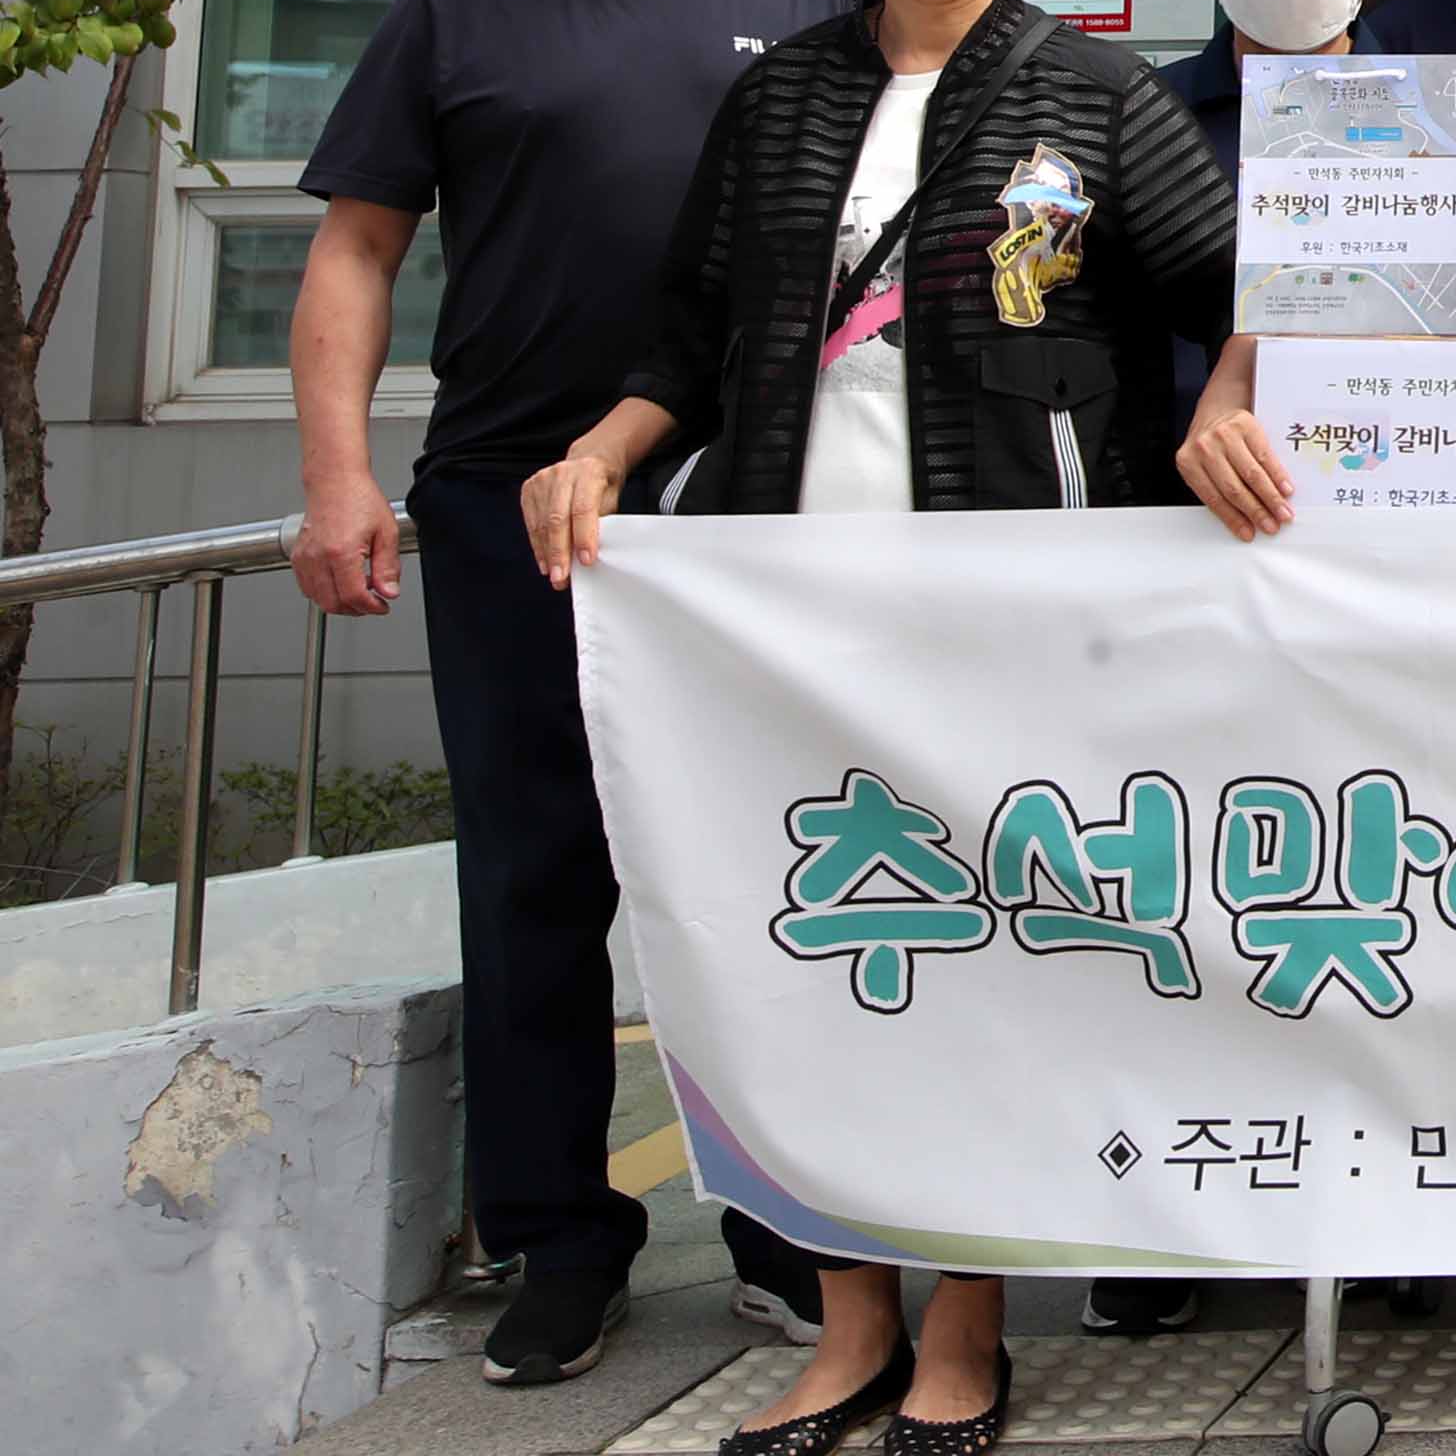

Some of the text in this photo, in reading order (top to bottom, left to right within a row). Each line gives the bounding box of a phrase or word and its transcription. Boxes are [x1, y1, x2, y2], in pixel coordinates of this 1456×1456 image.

[733, 36, 778, 54] FIL
[1251, 193, 1329, 217] 추석맞이
[1301, 241, 1323, 255] 후원
[1340, 241, 1408, 255] 한국기초소재
[1347, 377, 1393, 397] 만석동
[1286, 423, 1379, 454] 추석맞이
[1334, 487, 1364, 504] 후원
[1163, 1115, 1312, 1191] 주관
